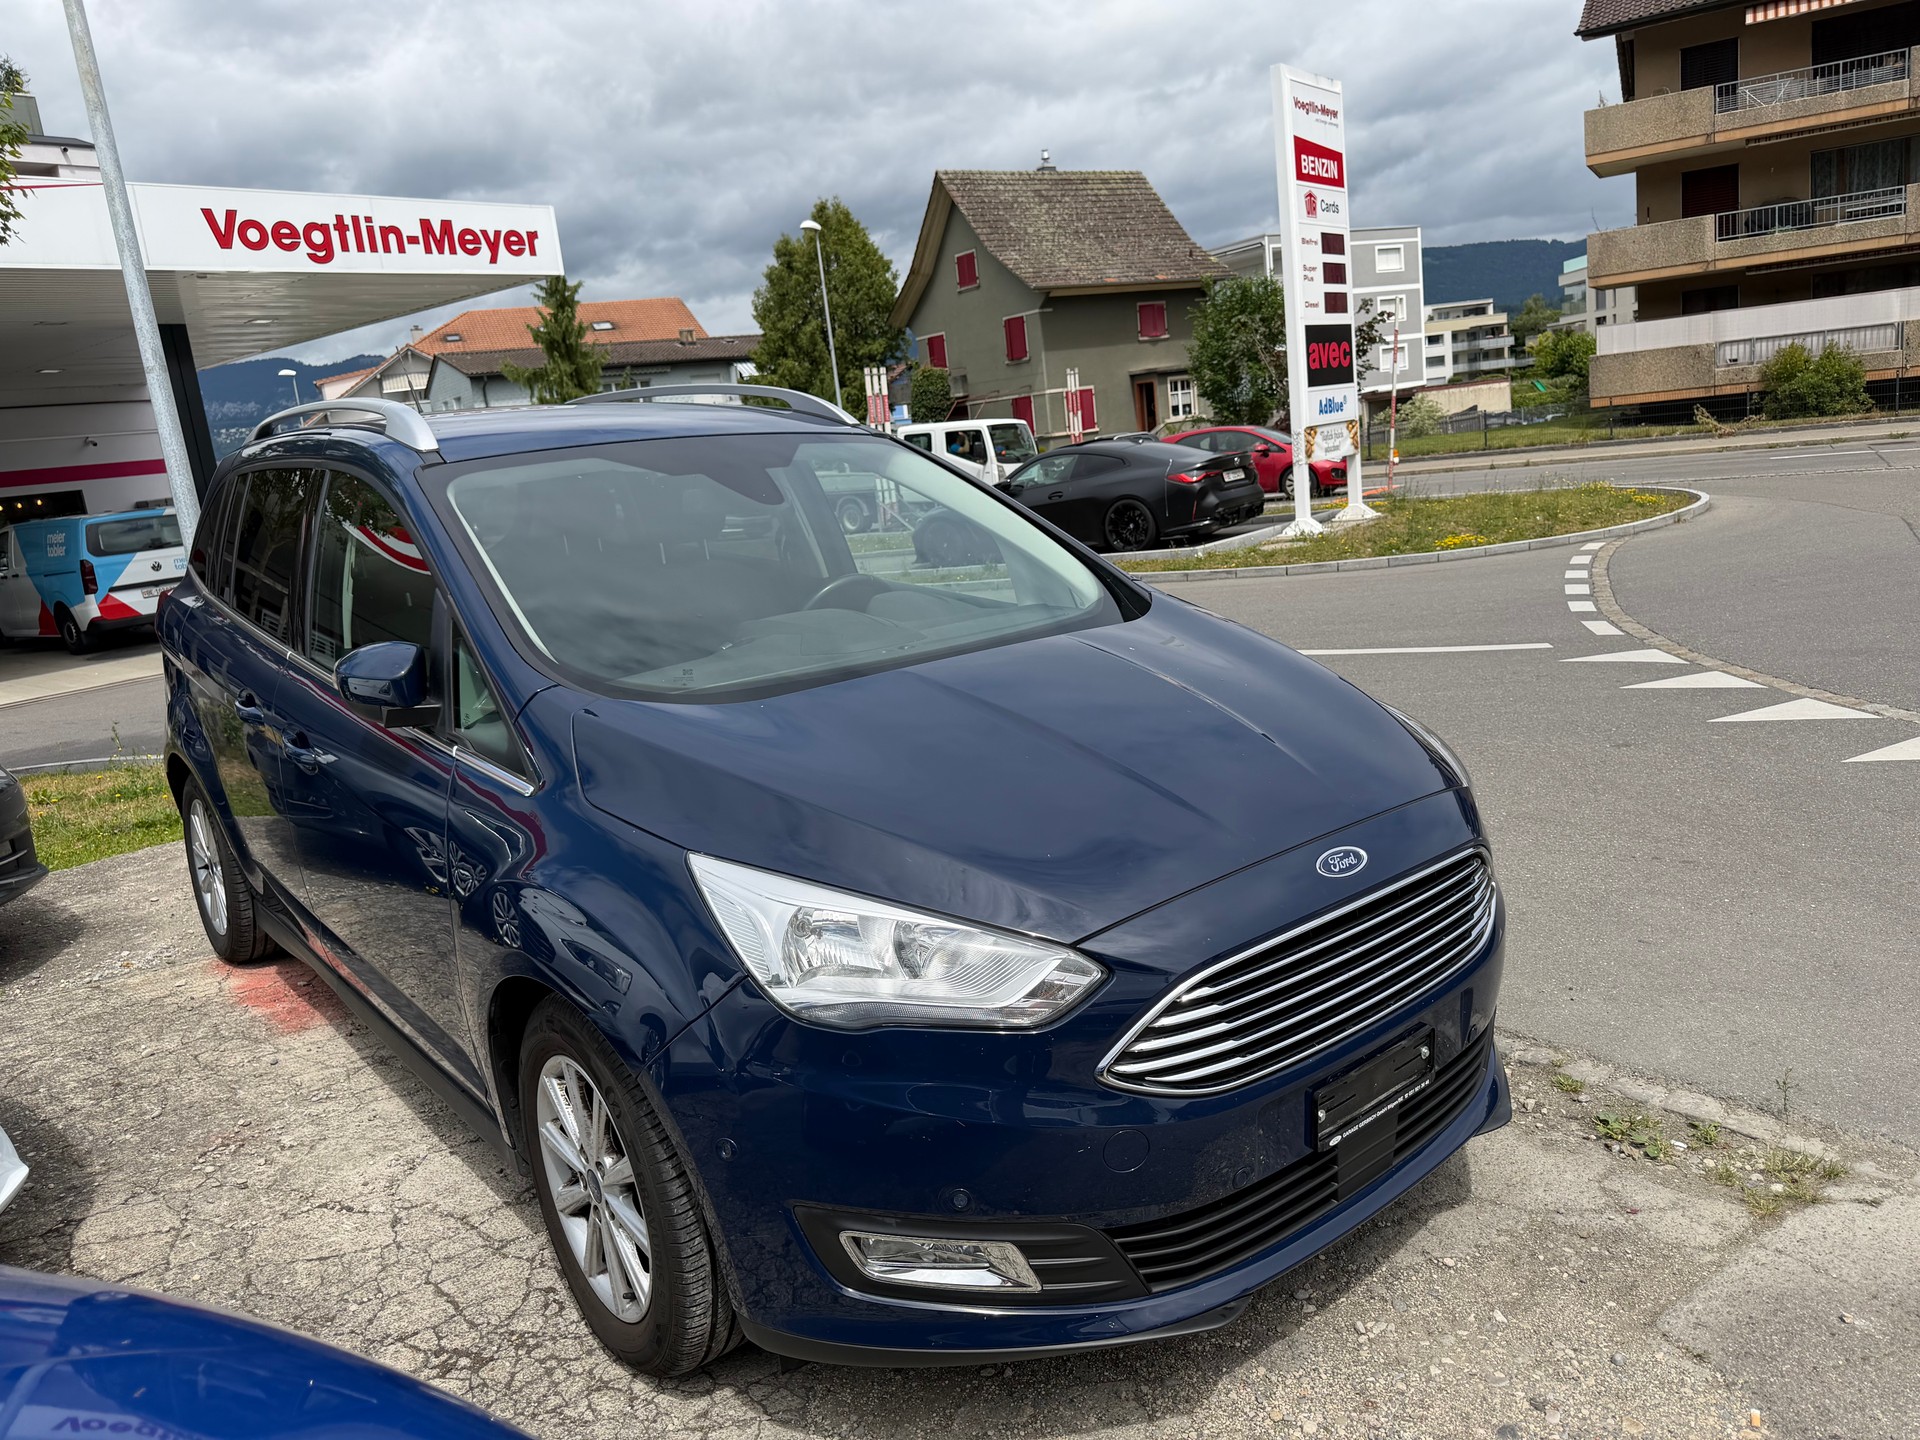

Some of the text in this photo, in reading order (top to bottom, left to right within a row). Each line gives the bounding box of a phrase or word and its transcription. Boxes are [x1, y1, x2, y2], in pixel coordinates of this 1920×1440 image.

[1293, 96, 1338, 120] Voegtlin-Meyer
[1301, 154, 1338, 179] BENZIN
[1320, 199, 1339, 214] Cards
[200, 207, 539, 264] Voegtlin-Meyer
[1303, 264, 1317, 273] Super
[1308, 341, 1351, 370] avec
[47, 530, 65, 544] meier
[48, 544, 66, 557] tobler
[1328, 852, 1357, 872] Ford
